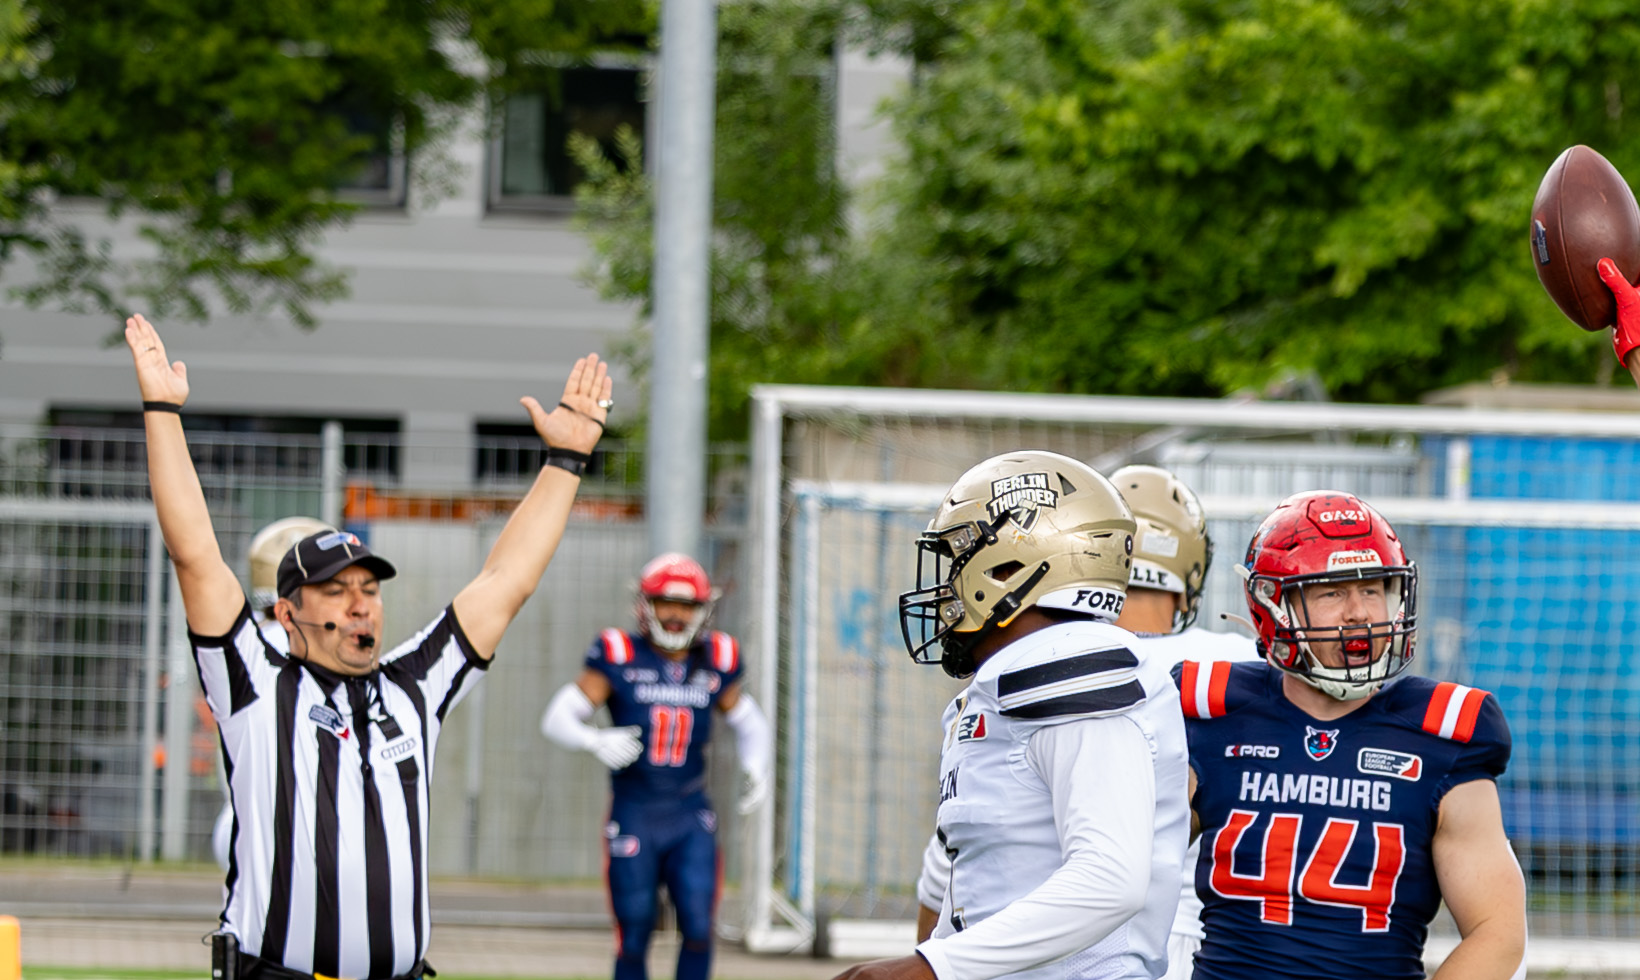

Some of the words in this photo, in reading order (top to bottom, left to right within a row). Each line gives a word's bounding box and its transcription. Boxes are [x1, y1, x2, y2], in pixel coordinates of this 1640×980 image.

[993, 473, 1047, 498] BERLIN
[989, 488, 1056, 518] THUNDER
[1319, 509, 1366, 523] GAZI
[1332, 554, 1377, 566] FORELLE
[649, 704, 694, 767] 11
[1239, 771, 1391, 812] HAMBURG
[1209, 808, 1406, 932] 44
